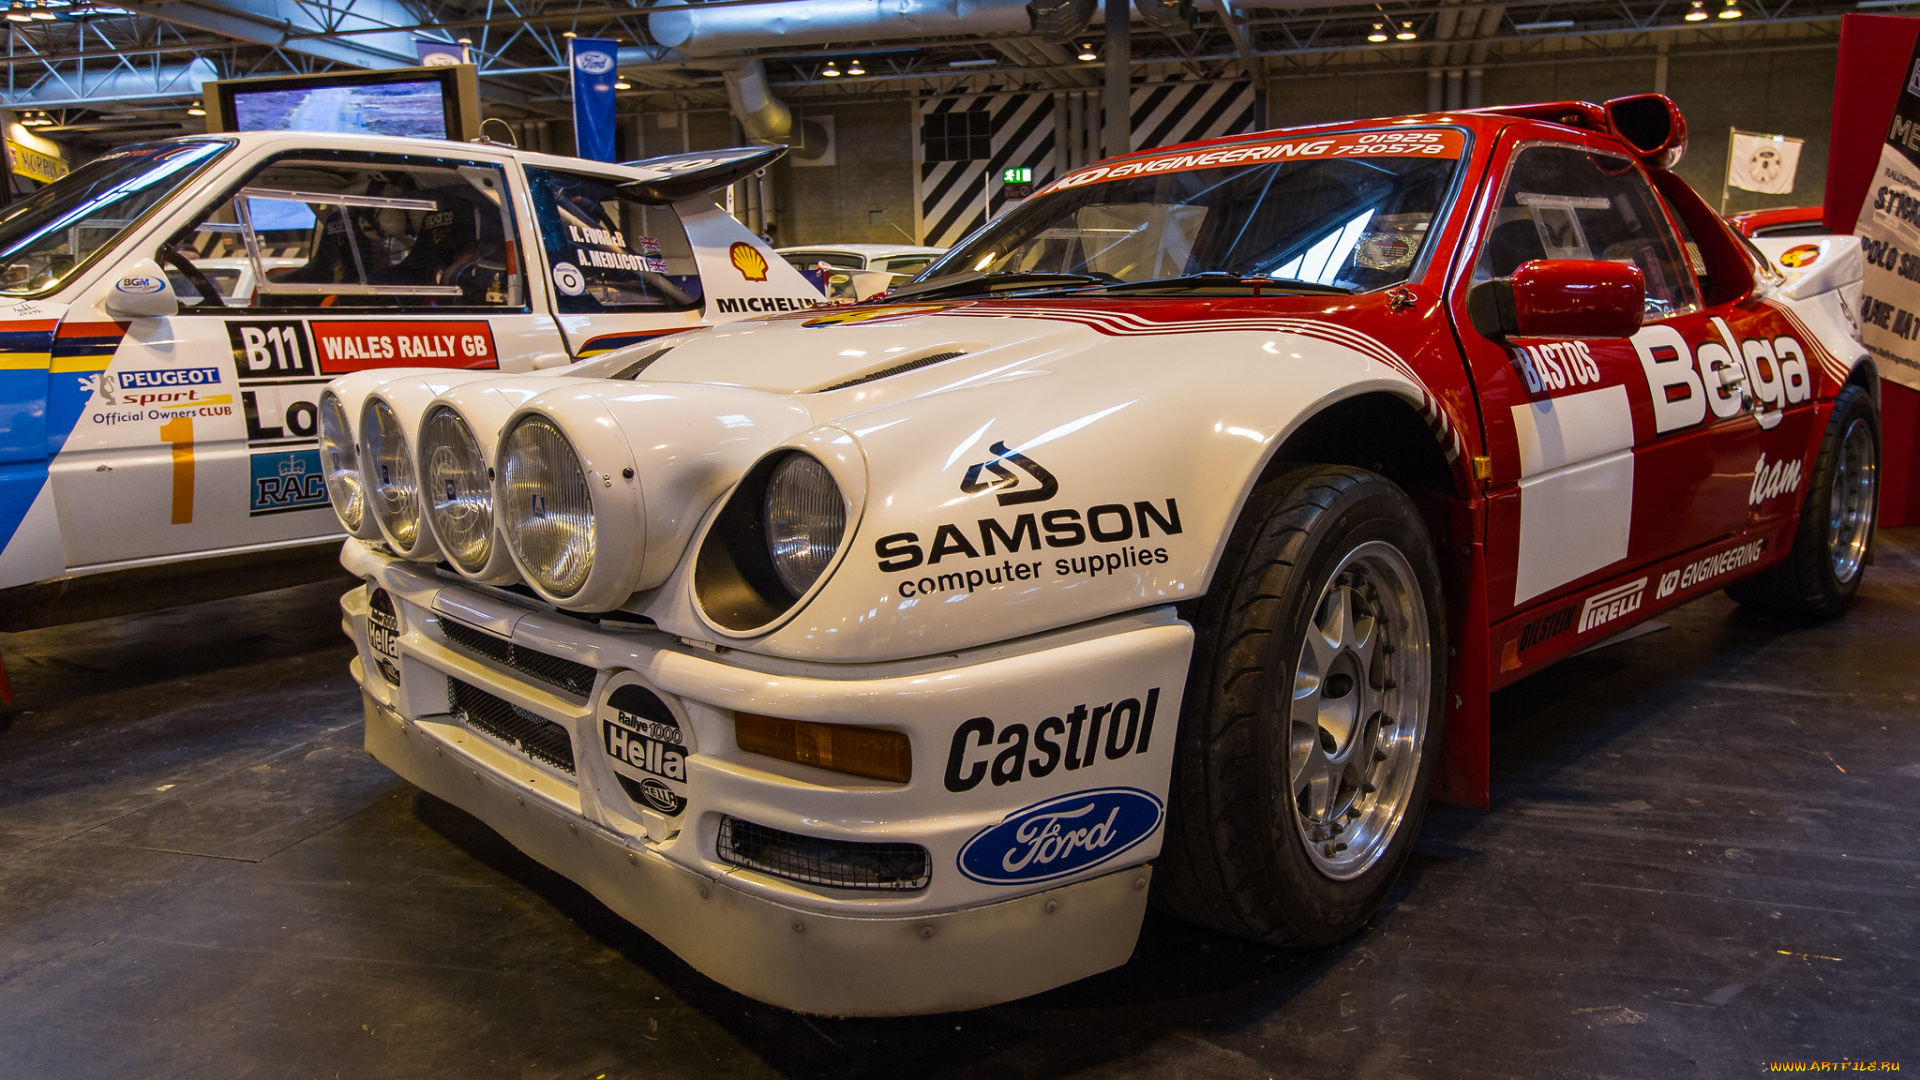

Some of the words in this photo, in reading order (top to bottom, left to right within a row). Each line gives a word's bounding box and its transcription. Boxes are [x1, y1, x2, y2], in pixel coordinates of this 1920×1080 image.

[580, 55, 608, 70] Ford
[1333, 144, 1446, 156] 730578
[1358, 132, 1443, 145] 01925
[20, 150, 59, 180] MORRIS
[1107, 140, 1335, 178] ENGINEERING
[569, 225, 584, 243] K.
[577, 249, 591, 266] A.
[589, 250, 650, 272] MEDLICOTT
[124, 278, 150, 286] BGM
[239, 325, 304, 371] B11
[322, 336, 394, 360] WALES
[397, 335, 455, 358] RALLY
[461, 335, 488, 357] GB
[121, 369, 216, 388] PEUGEOT
[1513, 340, 1600, 394] BASTOS
[1629, 316, 1811, 437] Belga
[93, 410, 144, 426] Official
[148, 409, 197, 420] Owners
[198, 406, 232, 417] CLUB
[122, 389, 200, 407] sport
[160, 417, 195, 525] 1
[1748, 452, 1801, 506] team
[256, 477, 324, 507] RAC
[874, 498, 1183, 573] SAMSON
[898, 559, 1042, 599] computer
[1055, 546, 1169, 578] supplies
[1656, 569, 1681, 600] KD
[1680, 538, 1765, 590] ENGINEERING
[1578, 576, 1648, 635] PIRELLI
[369, 620, 398, 657] Hella
[1518, 603, 1578, 653] BILSTEIN
[618, 710, 649, 733] Rallye
[648, 722, 684, 744] 1000
[943, 686, 1161, 793] Castrol
[609, 724, 685, 781] Hella
[643, 785, 677, 806] HELLA
[1002, 802, 1121, 873] Ford
